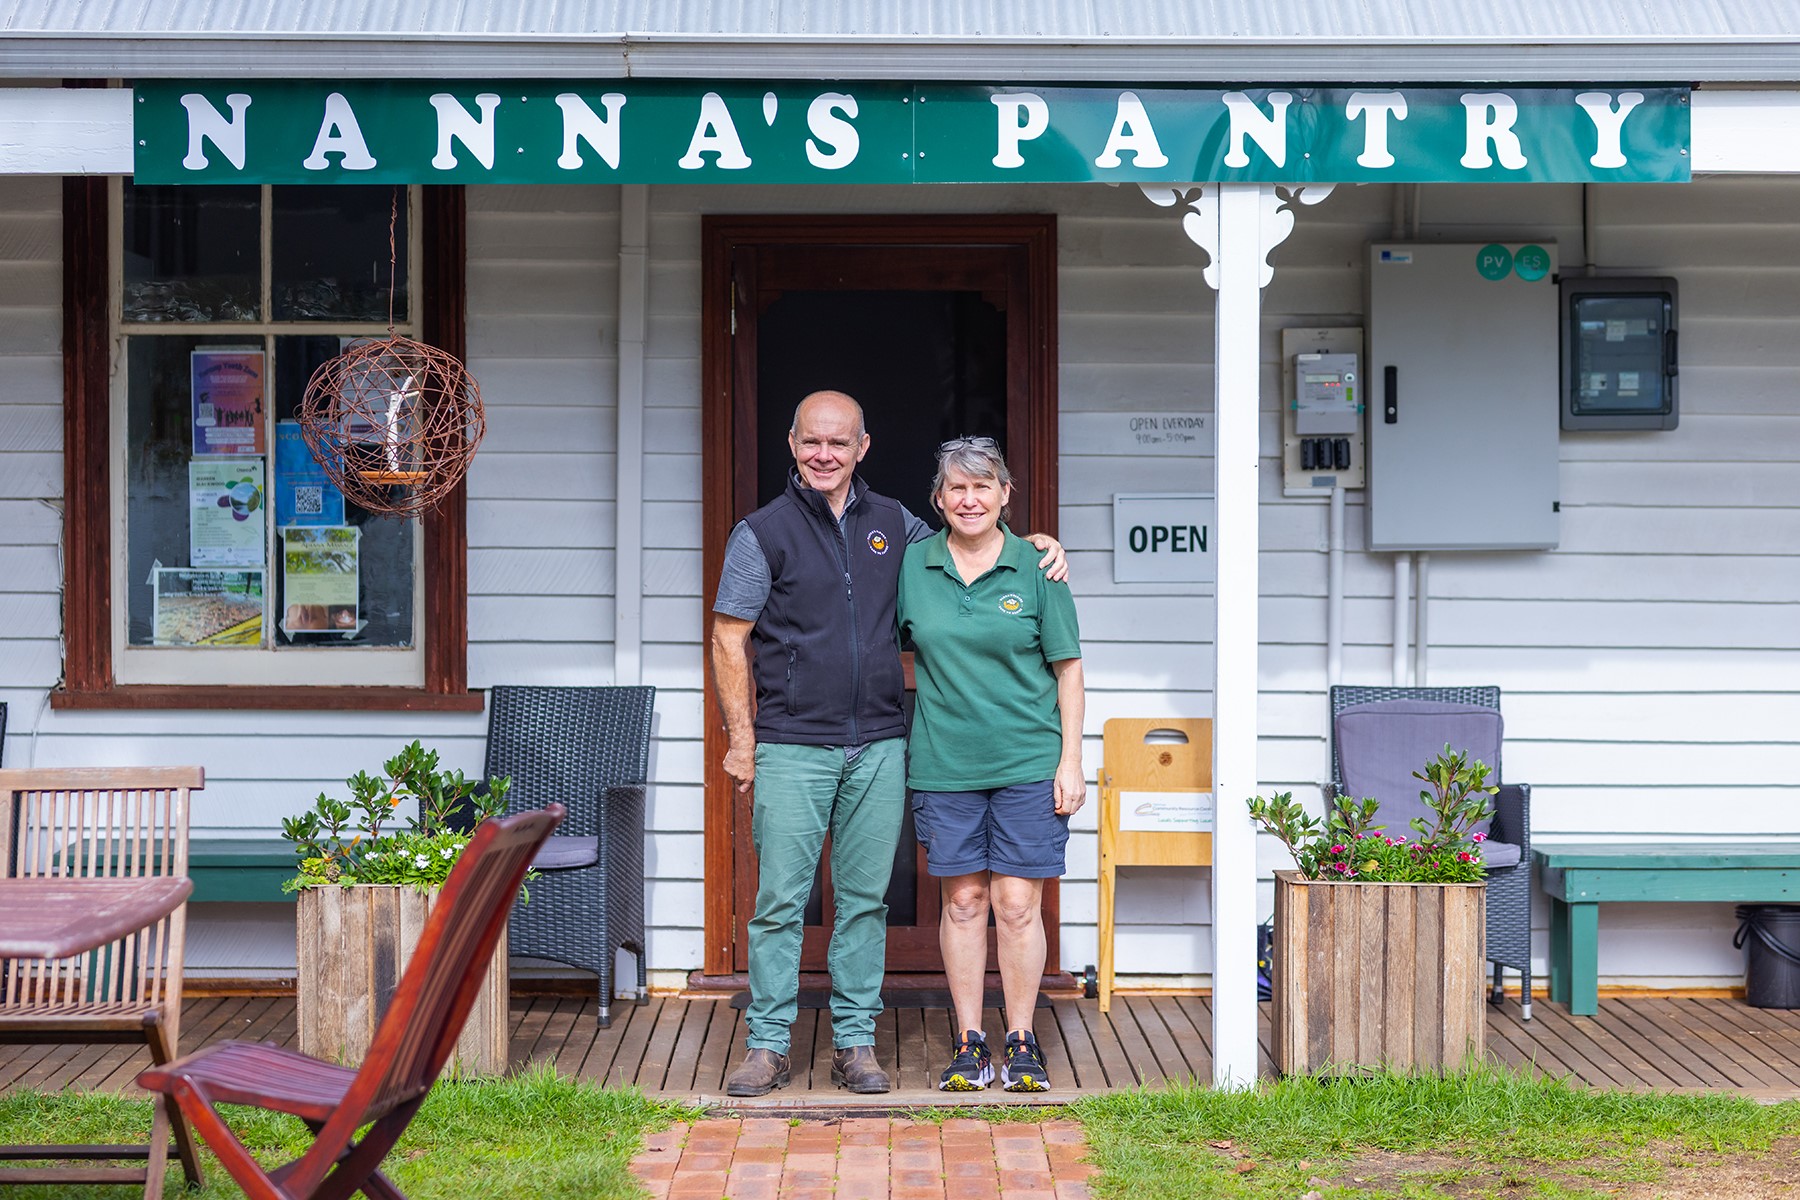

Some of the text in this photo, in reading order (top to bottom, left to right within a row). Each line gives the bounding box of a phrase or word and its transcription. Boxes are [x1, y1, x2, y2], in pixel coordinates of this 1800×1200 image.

[181, 92, 1644, 169] NANNA'S PANTRY
[1484, 256, 1504, 268] PV
[1522, 256, 1541, 268] ES
[1129, 417, 1205, 431] OPEN EVERYDAY
[1129, 525, 1208, 553] OPEN
